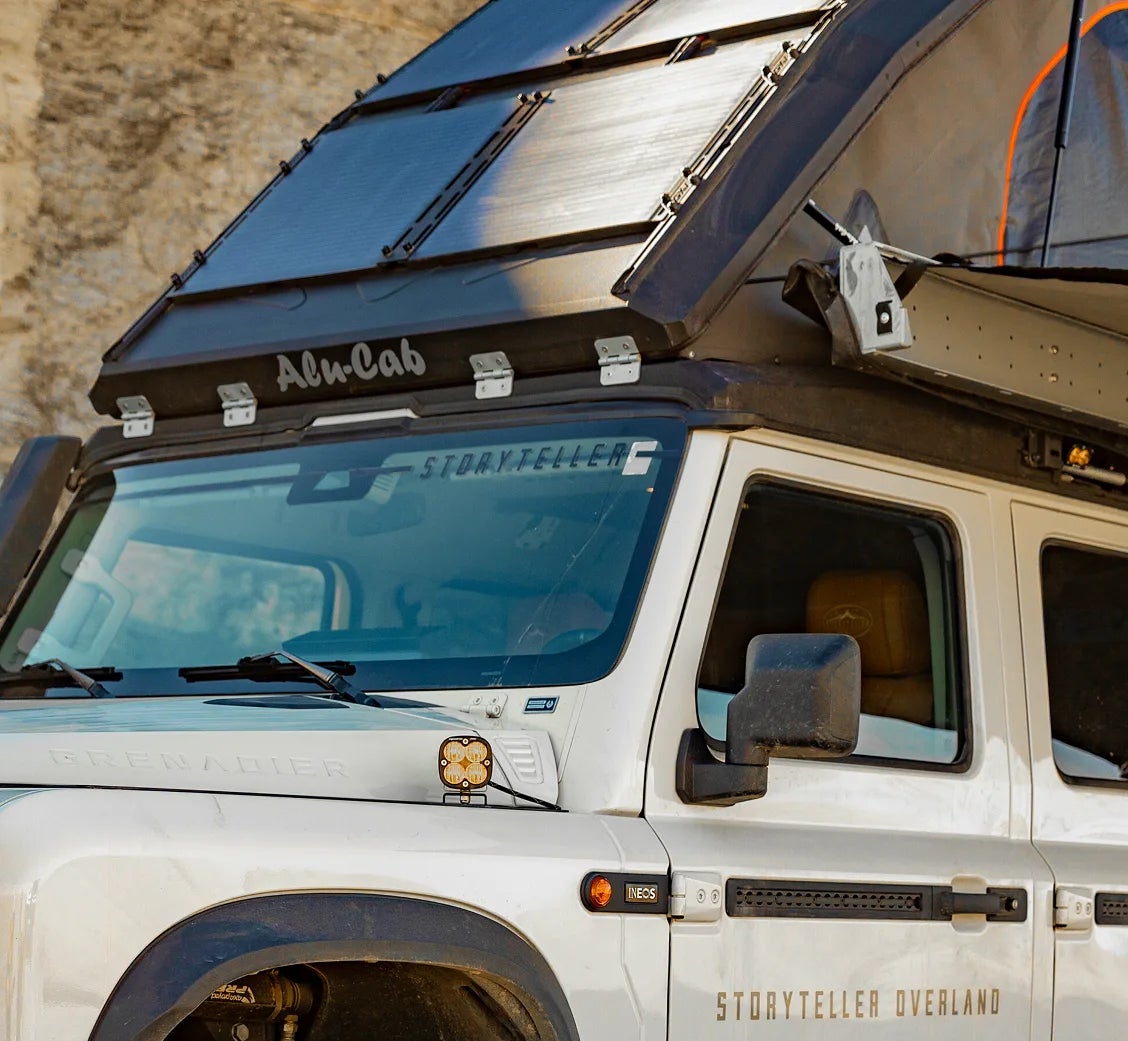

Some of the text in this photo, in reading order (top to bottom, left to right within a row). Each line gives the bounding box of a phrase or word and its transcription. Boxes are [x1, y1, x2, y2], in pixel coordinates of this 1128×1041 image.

[276, 337, 427, 393] Alu-Cab
[418, 442, 627, 481] STORYTELLER
[47, 747, 351, 779] GRENADIER
[628, 887, 657, 900] INEOS
[716, 987, 1001, 1022] STORYTELLER OVERLAND
